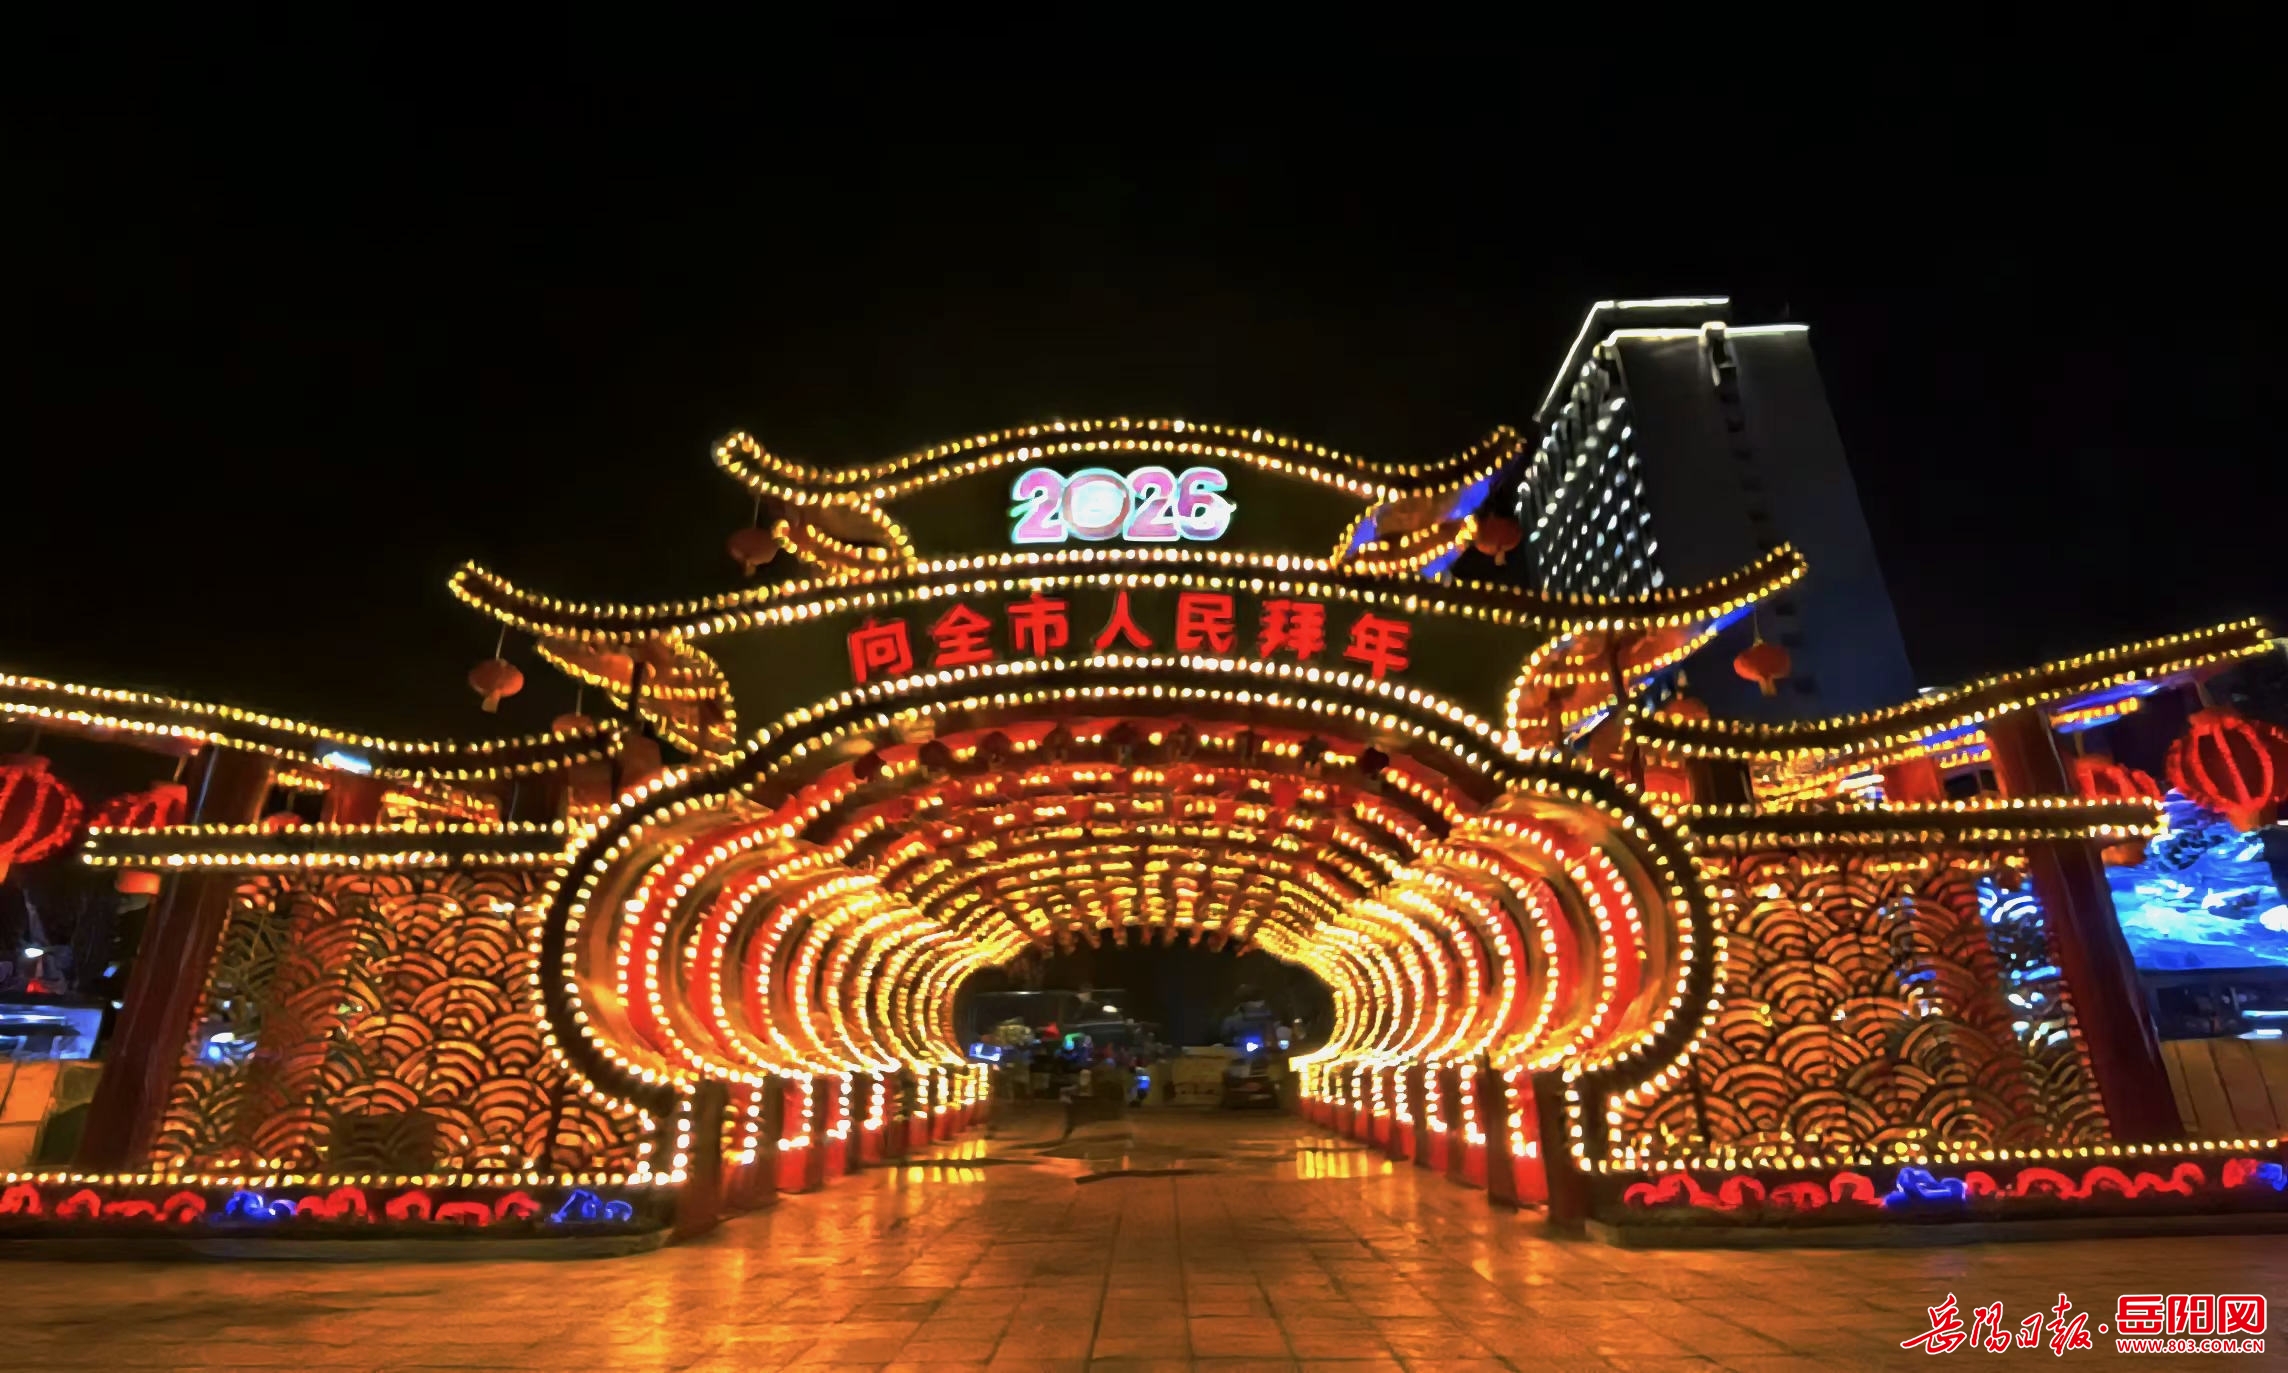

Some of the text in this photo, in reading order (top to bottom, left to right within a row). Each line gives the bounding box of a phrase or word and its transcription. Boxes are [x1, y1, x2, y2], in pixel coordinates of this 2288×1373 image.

[1010, 466, 1236, 542] 2026
[847, 591, 1411, 682] 向全市人民拜年
